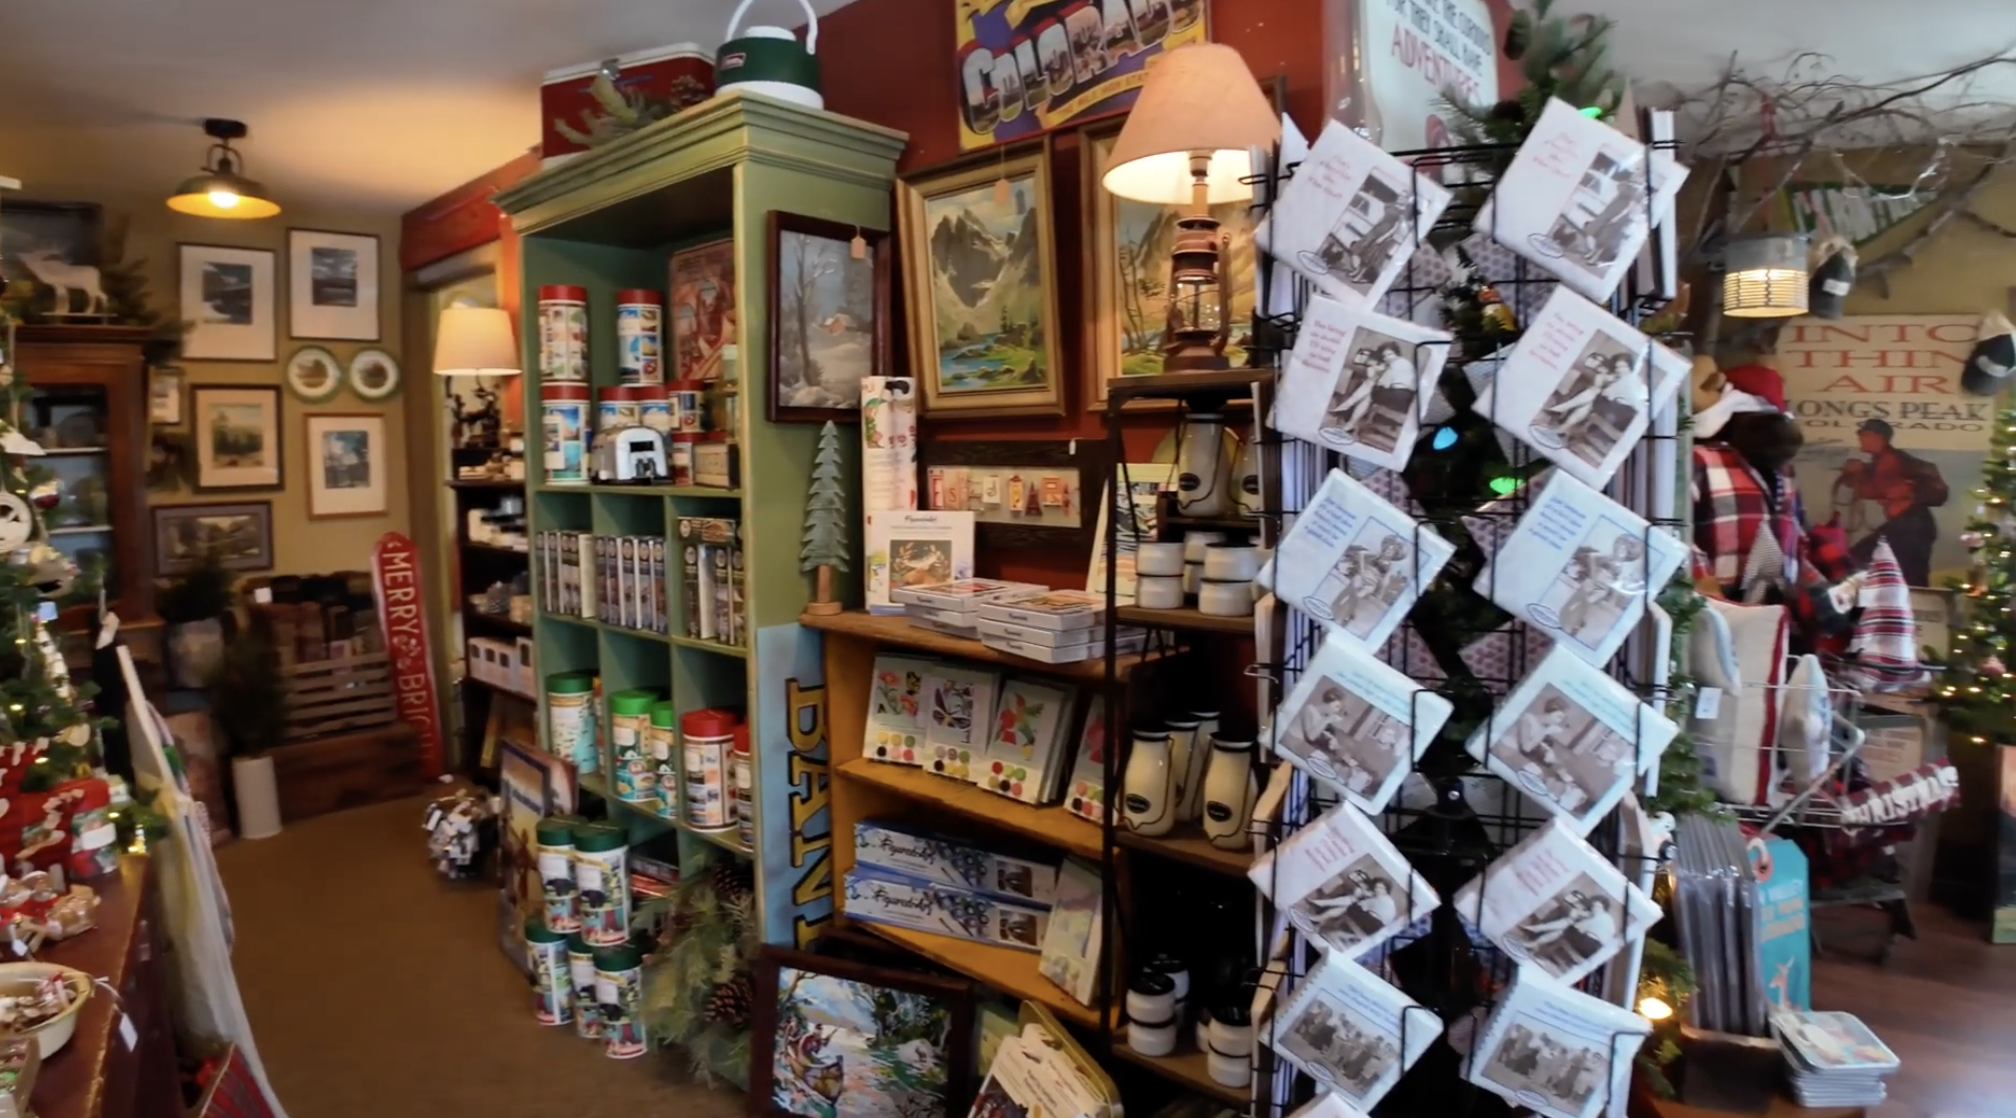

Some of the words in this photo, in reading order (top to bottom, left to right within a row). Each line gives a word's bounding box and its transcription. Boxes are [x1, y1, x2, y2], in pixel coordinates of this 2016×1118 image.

[1787, 323, 1978, 344] INTO
[1787, 349, 1970, 369] THIN
[1816, 374, 1955, 395] AIR
[1790, 398, 1891, 419] ONGS
[1899, 401, 1990, 421] PEAK
[1804, 419, 1984, 433] OLRADO
[382, 551, 421, 634] MERRY
